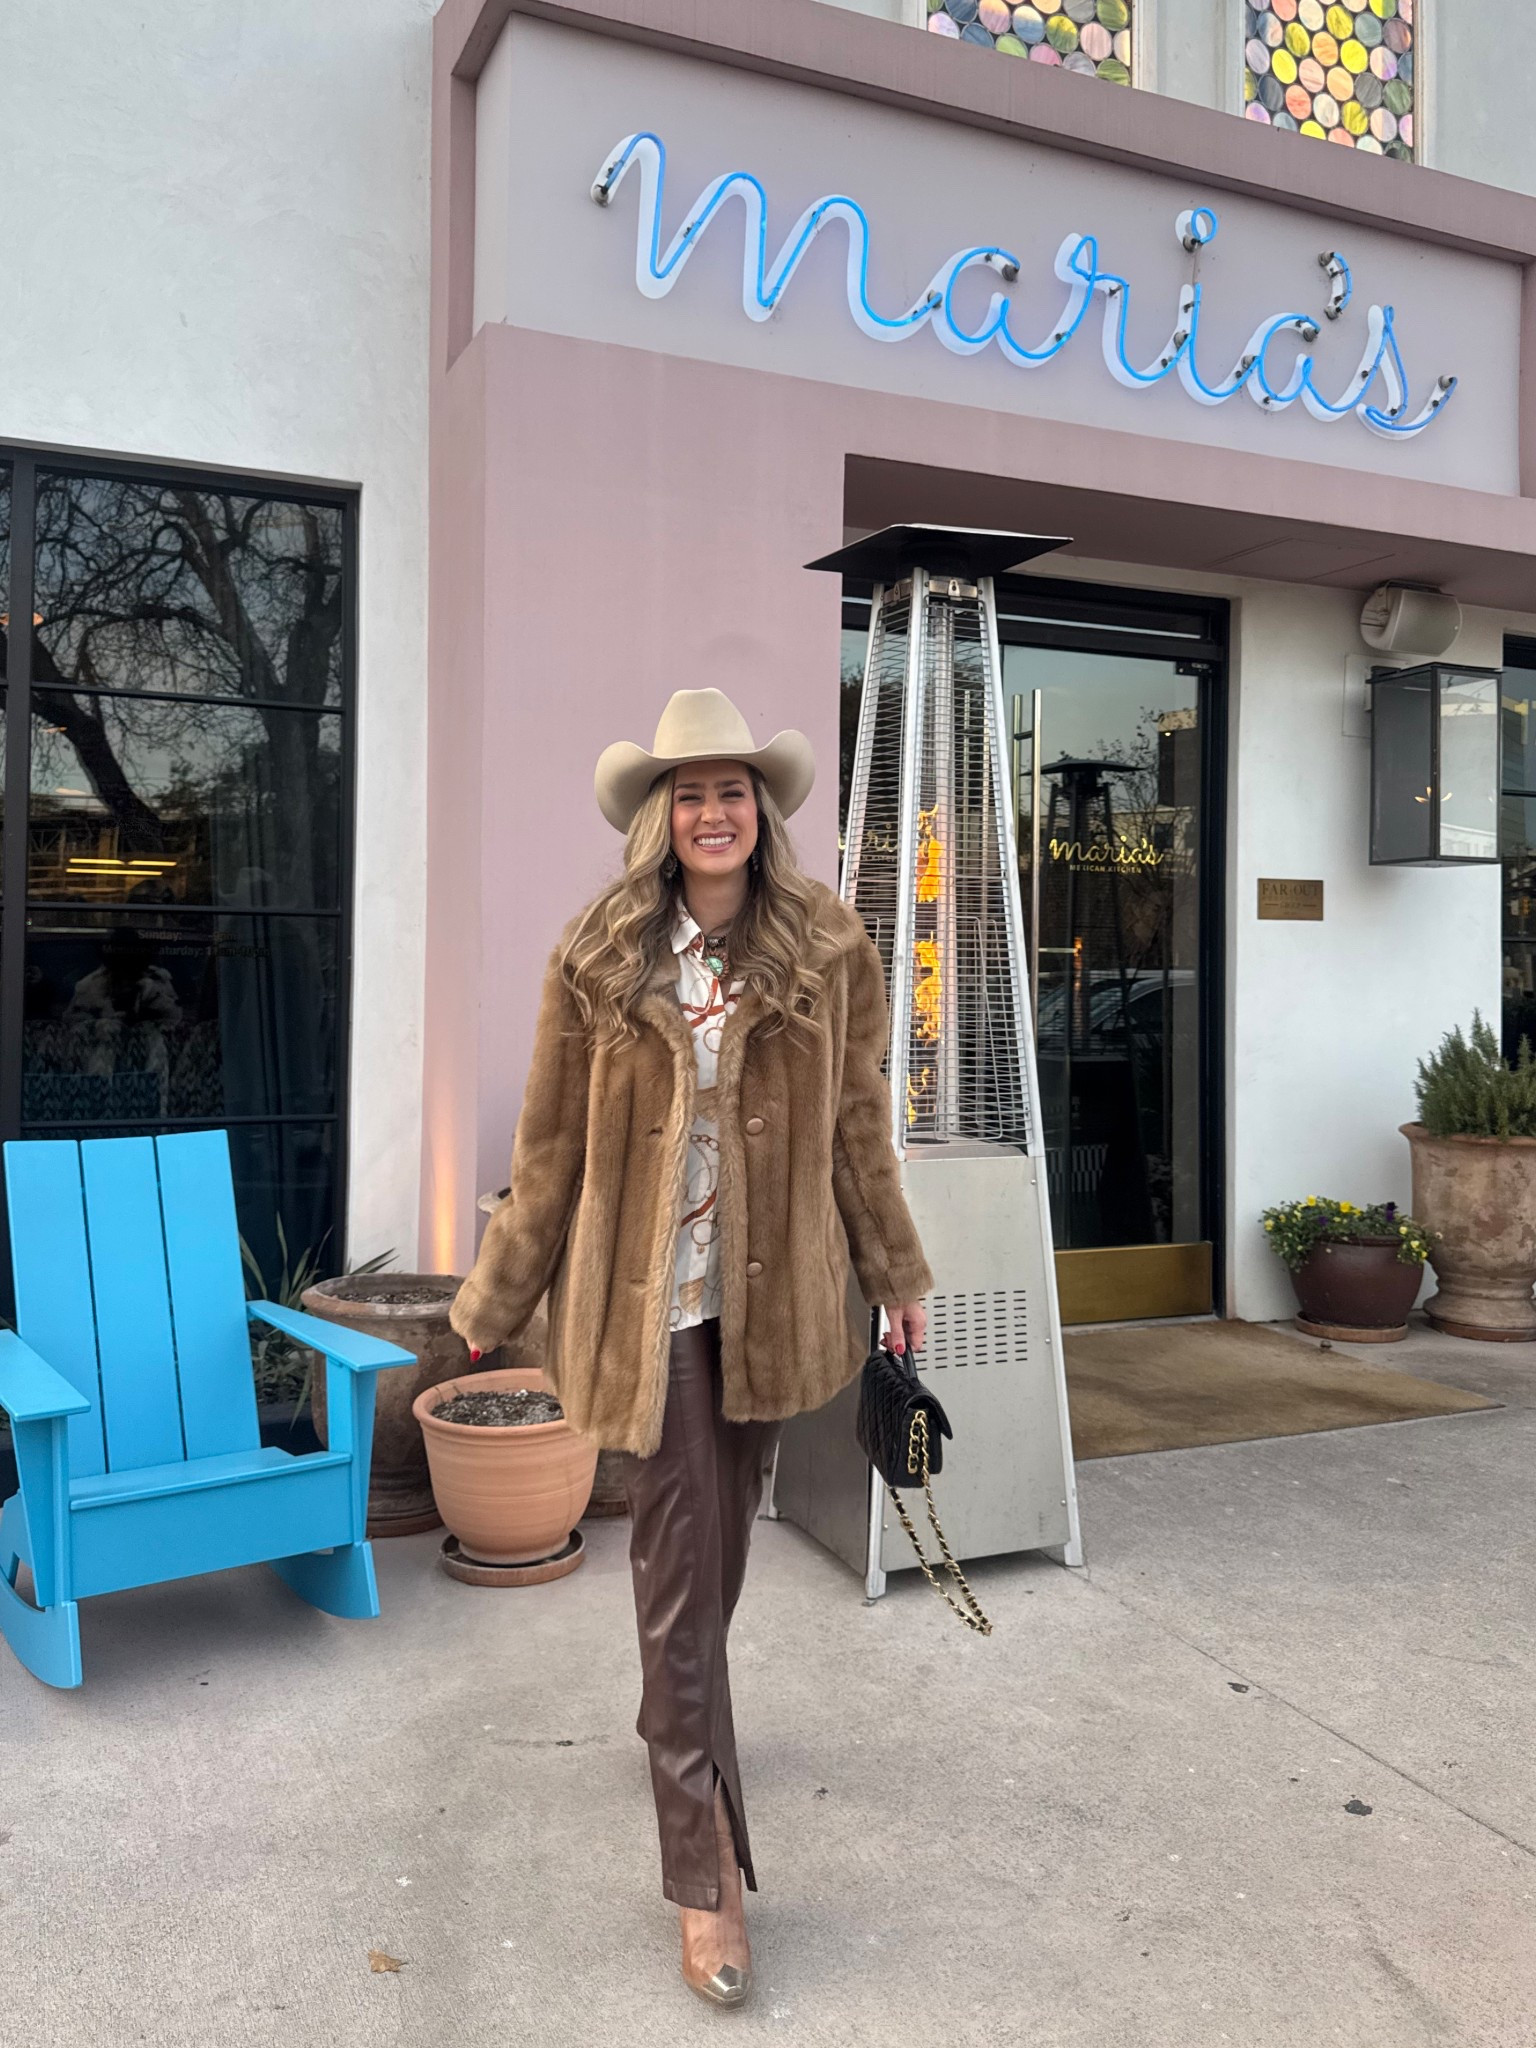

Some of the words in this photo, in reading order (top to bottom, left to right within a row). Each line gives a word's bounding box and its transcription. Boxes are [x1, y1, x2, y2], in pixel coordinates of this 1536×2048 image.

[1069, 864, 1105, 872] MEXICAN
[1107, 865, 1142, 873] KITCHEN
[1262, 883, 1288, 895] FAR
